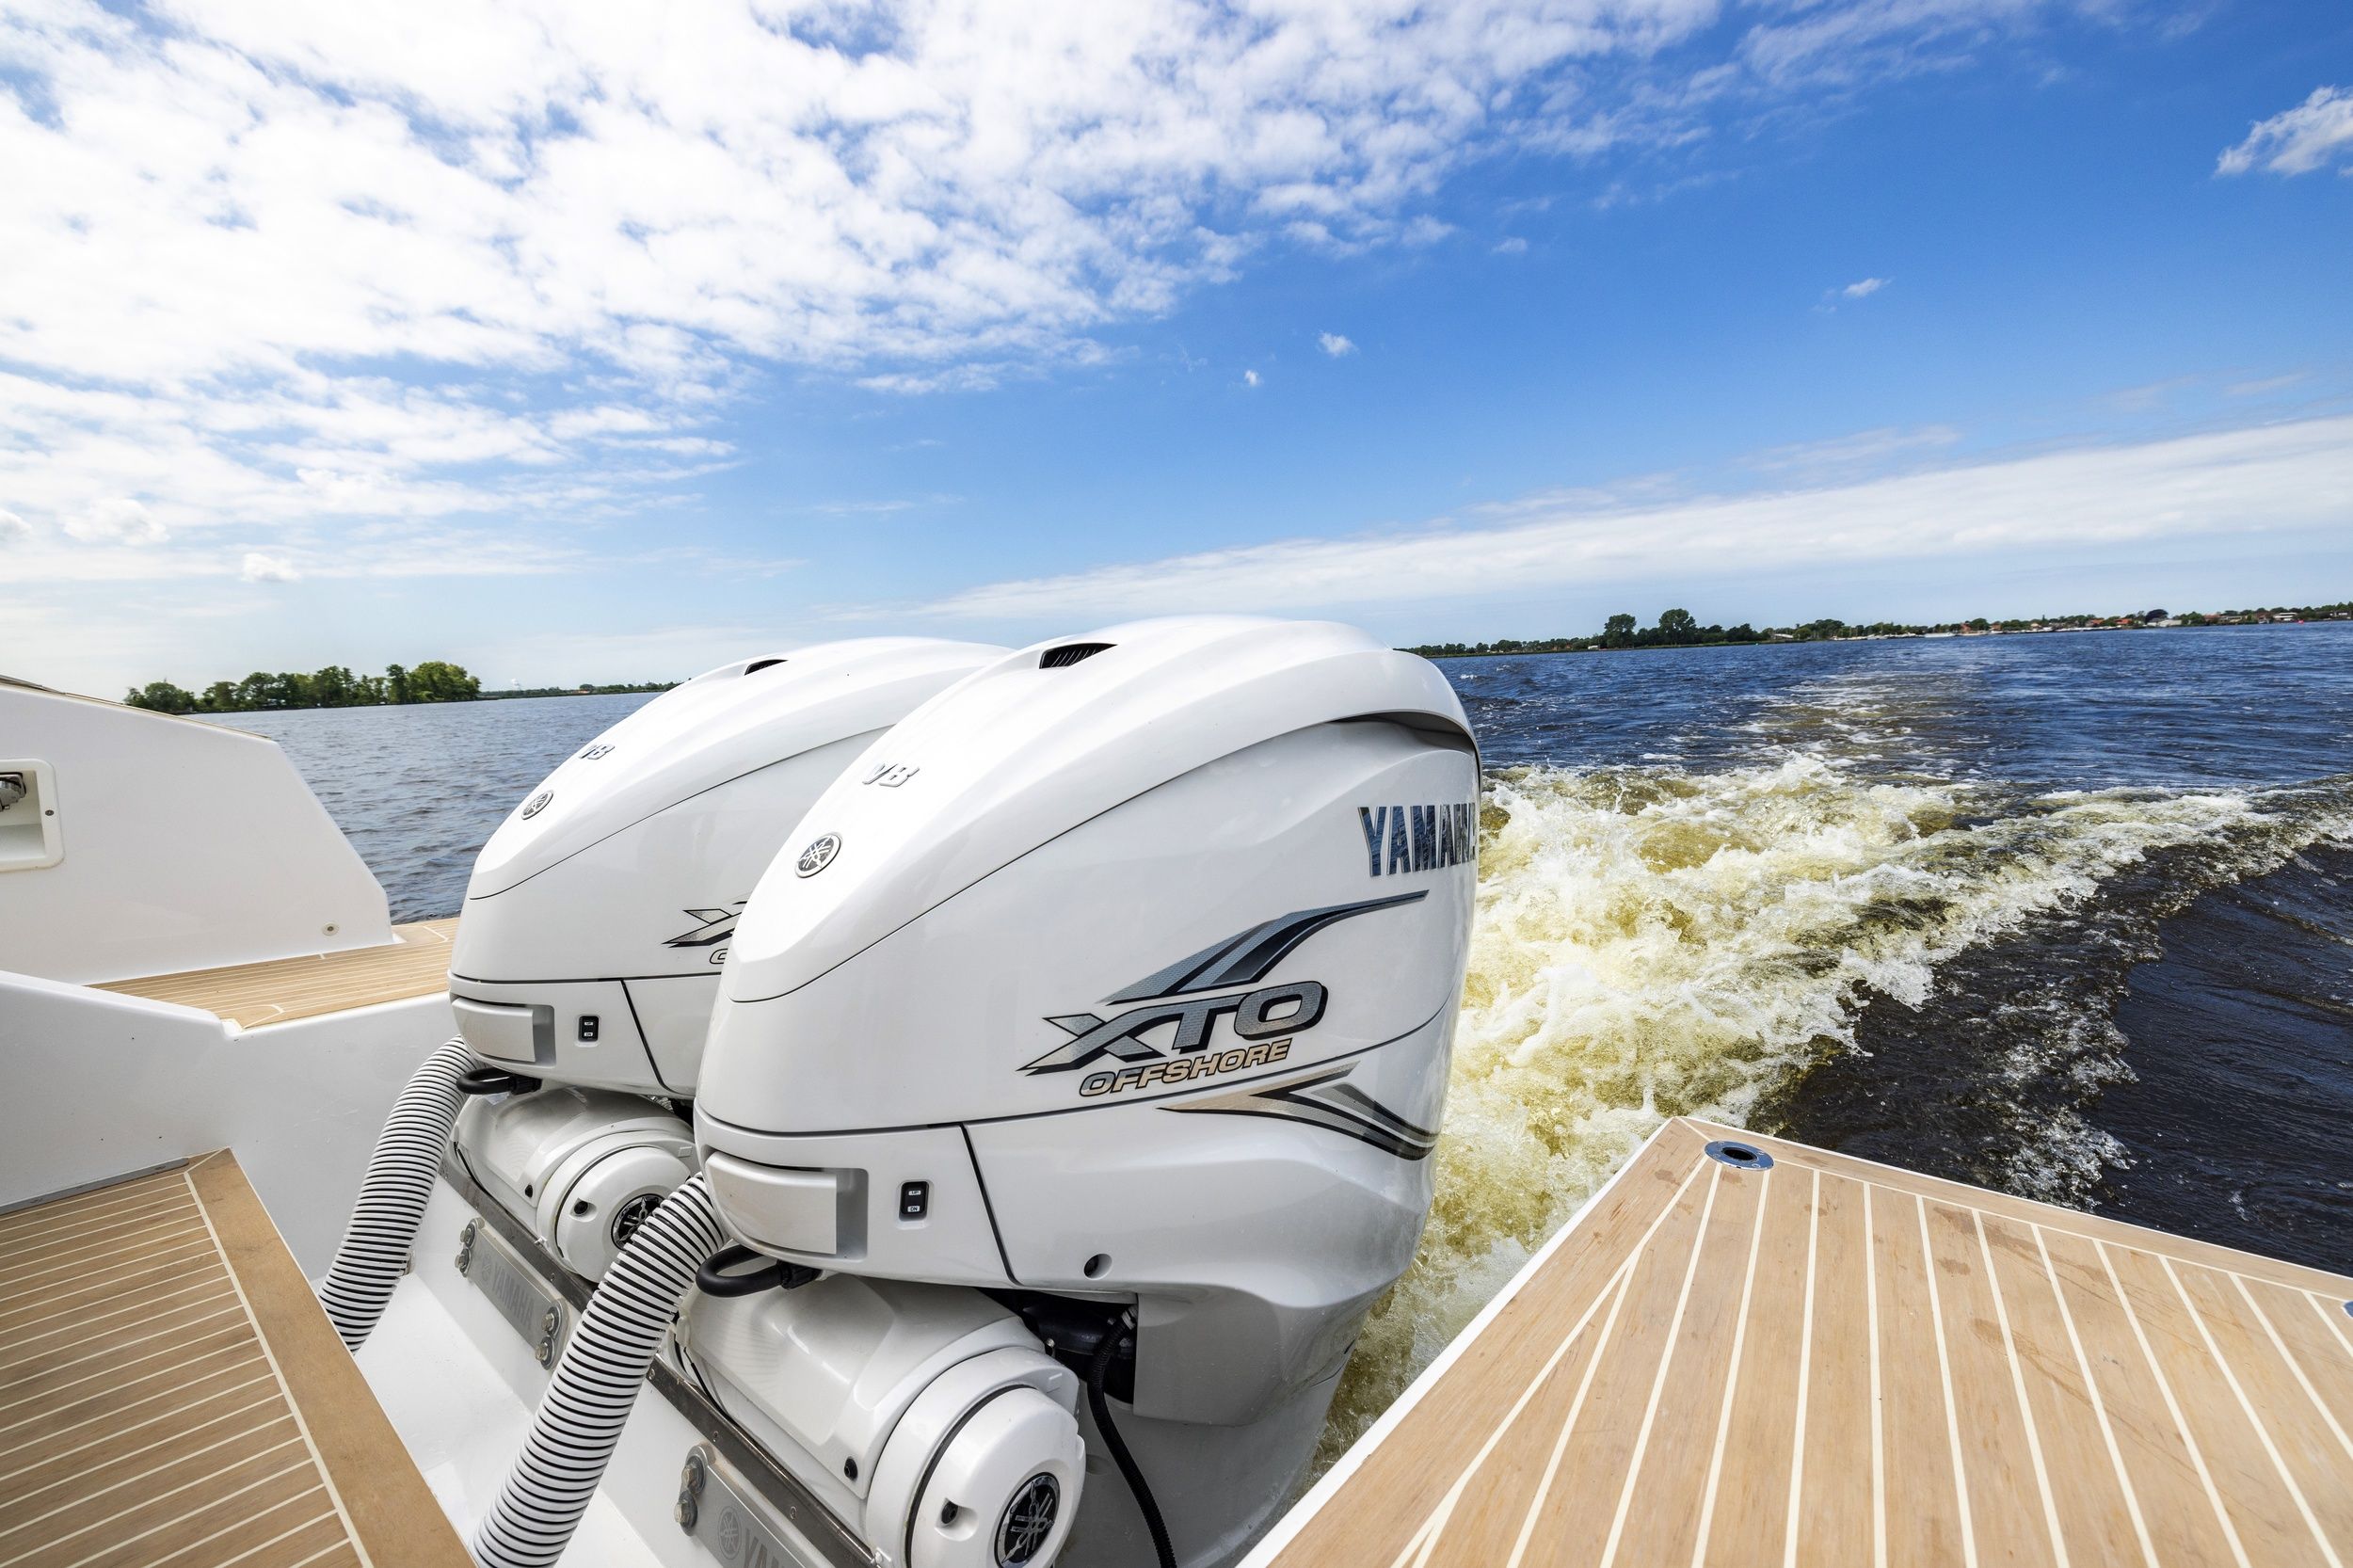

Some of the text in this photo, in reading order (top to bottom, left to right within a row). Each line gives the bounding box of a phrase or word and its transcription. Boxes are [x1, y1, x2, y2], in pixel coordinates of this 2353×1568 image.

[1016, 980, 1329, 1077] XTO
[1079, 1037, 1293, 1097] OFFSHORE
[491, 1261, 535, 1331] YAMAHA
